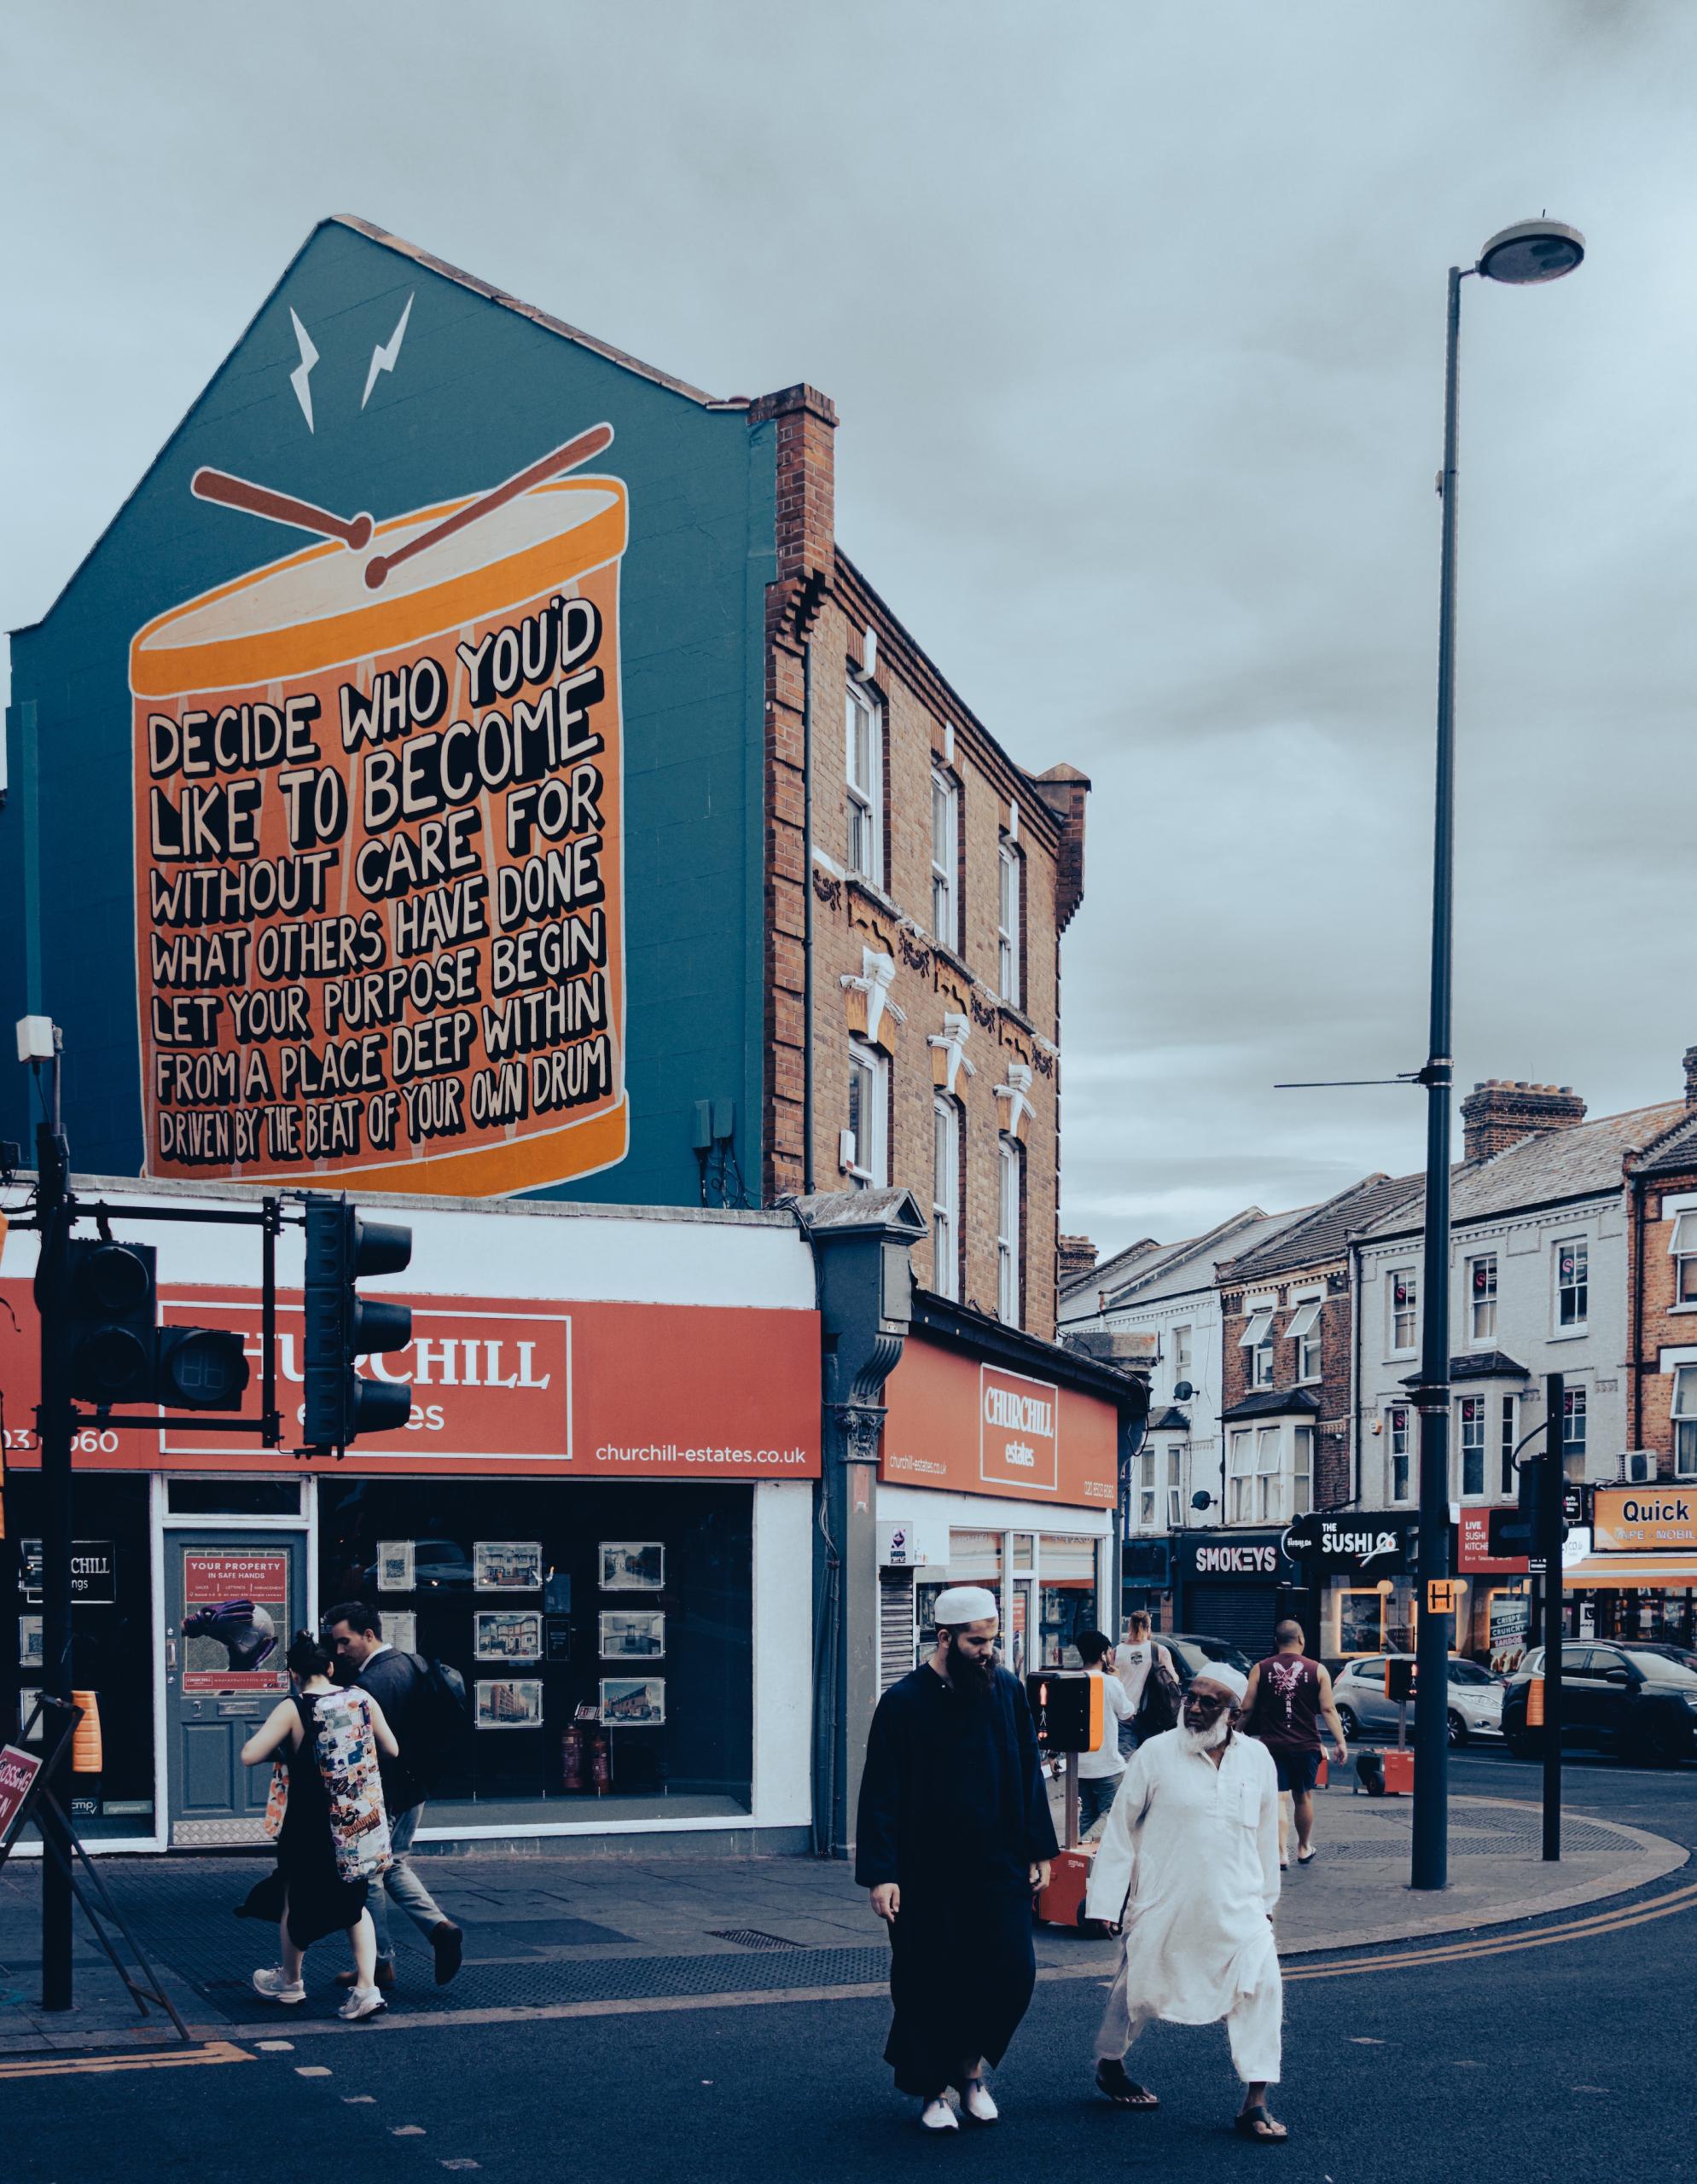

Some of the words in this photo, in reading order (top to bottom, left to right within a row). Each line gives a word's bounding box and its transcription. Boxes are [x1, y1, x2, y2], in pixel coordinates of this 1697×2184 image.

[148, 694, 319, 776] DECIDE
[338, 657, 444, 750] WHO
[456, 595, 599, 704] YOU'D
[149, 779, 259, 858] LIKE
[278, 766, 342, 846] TO
[363, 670, 601, 831] BECOME
[150, 851, 334, 922] WITHOUT
[354, 810, 479, 897] CARE
[506, 764, 602, 852] FOR
[150, 928, 249, 985] WHAT
[256, 911, 384, 979] OTHERS
[396, 877, 486, 956] HAVE
[497, 835, 601, 920] DONE
[151, 995, 220, 1045] LET
[227, 985, 308, 1040] YOUR
[323, 947, 478, 1031] PURPOSE
[491, 910, 602, 993] BEGIN
[155, 1053, 239, 1101] FROM
[244, 1049, 270, 1099] A
[280, 1034, 385, 1095] PLACE
[391, 1012, 474, 1080] DEEP
[481, 971, 602, 1059] WITHIN
[158, 1112, 231, 1159] DRIVEN
[233, 1110, 259, 1159] BY
[265, 1106, 300, 1157] THE
[305, 1100, 362, 1155] BEAT
[368, 1093, 399, 1148] OF
[402, 1078, 461, 1141] YOUR
[470, 1063, 525, 1127] OWN
[532, 1036, 608, 1109] DRUM
[984, 1385, 1055, 1439] CHURCHILL
[596, 1443, 806, 1464] churchill-estates.co.uk
[1004, 1440, 1035, 1467] estates
[1622, 1499, 1690, 1524] Quick
[1322, 1523, 1338, 1532] THE
[1465, 1521, 1482, 1531] LIVE
[1465, 1531, 1486, 1541] SUSHI
[1322, 1533, 1373, 1553] SUSHI
[1464, 1542, 1489, 1551] KITCHE
[71, 1557, 110, 1574] CHILL
[224, 1562, 281, 1571] PROPERTY
[1195, 1546, 1276, 1572] SMOKEYS
[71, 1579, 89, 1591] ngs
[1492, 1623, 1526, 1636] CRUNCHY
[1496, 1613, 1521, 1625] CRISPY
